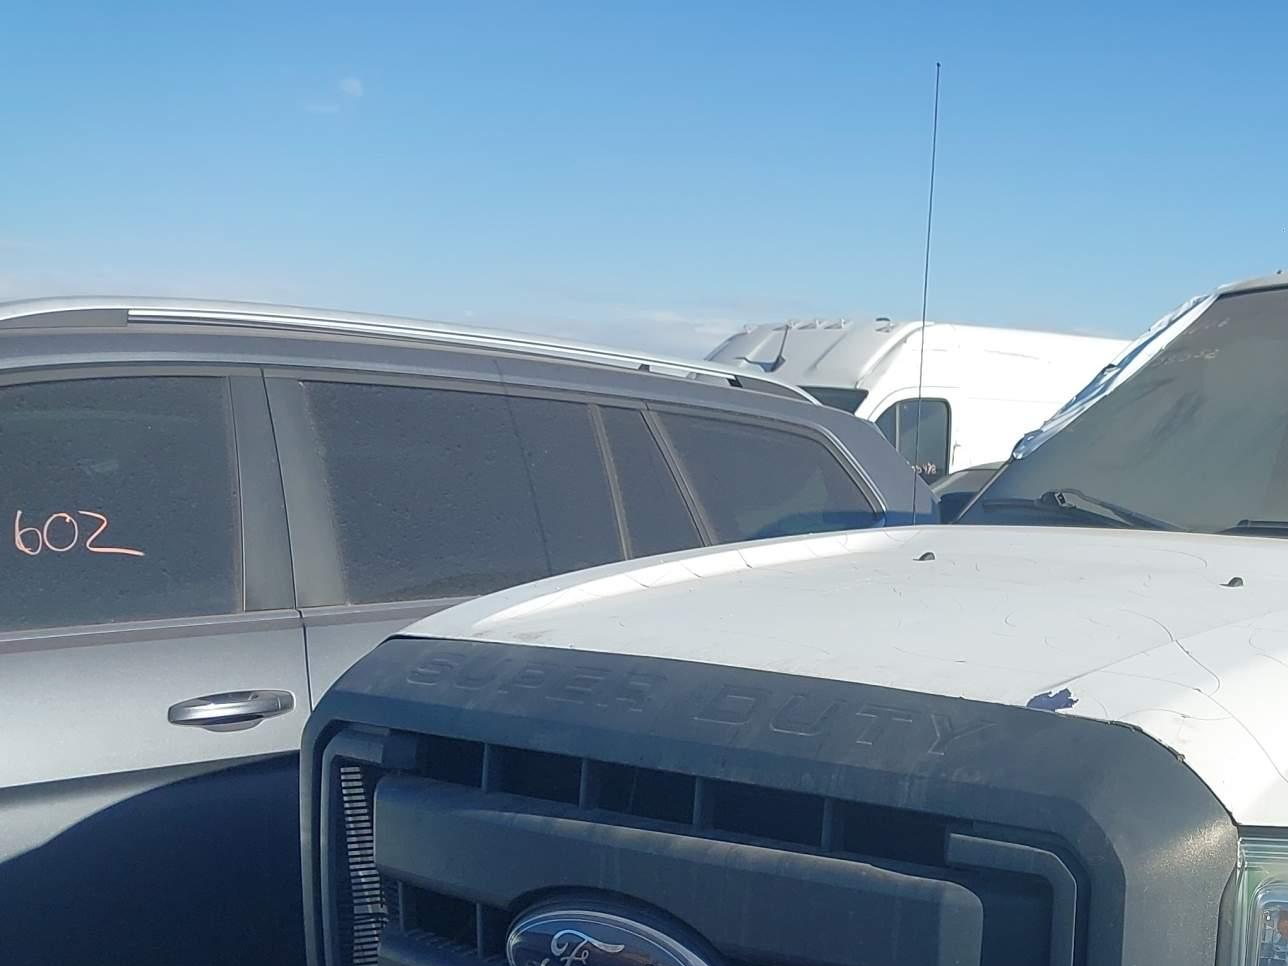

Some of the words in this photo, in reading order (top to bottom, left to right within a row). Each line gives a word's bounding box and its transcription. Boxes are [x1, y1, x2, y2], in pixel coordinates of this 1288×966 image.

[15, 510, 145, 556] 602
[405, 652, 668, 713] SUPER
[692, 684, 1000, 756] DUTY
